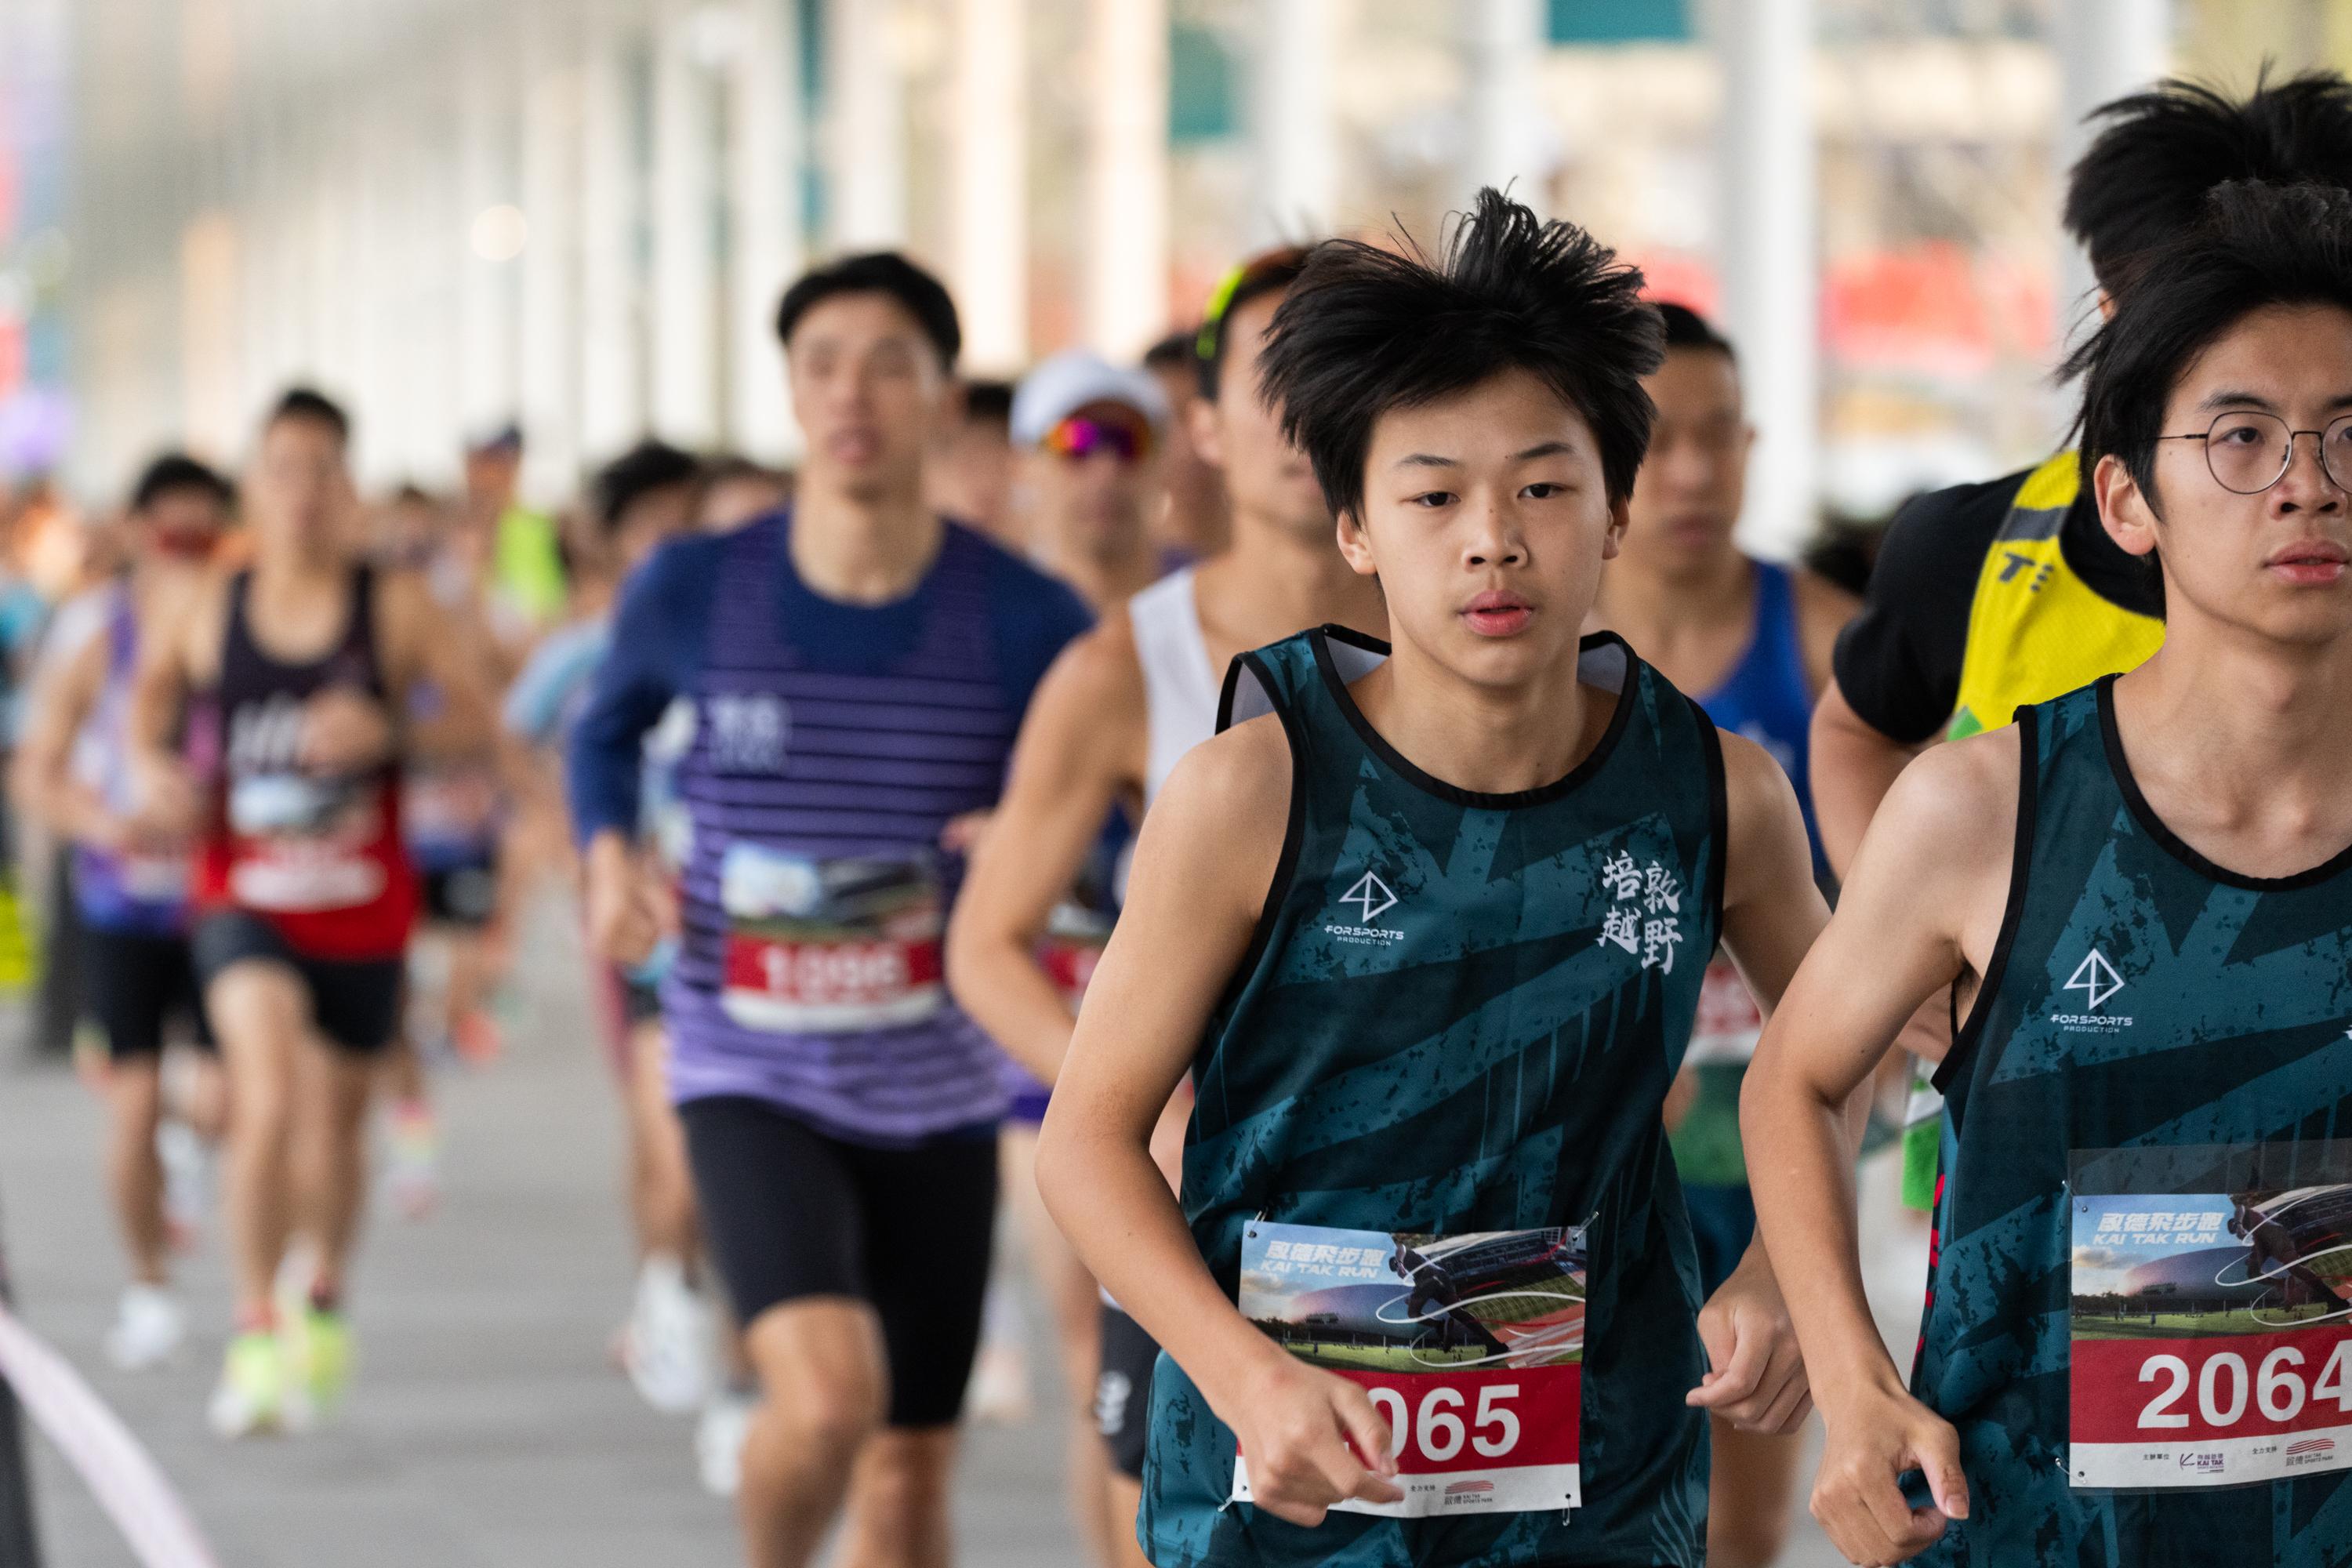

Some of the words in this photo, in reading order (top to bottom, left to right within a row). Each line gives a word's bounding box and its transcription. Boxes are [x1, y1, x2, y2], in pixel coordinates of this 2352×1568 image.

[1324, 925, 1404, 940] FORSPORTS
[1337, 936, 1392, 946] PRODUCTION
[2050, 1014, 2132, 1026] FORSPORTS
[2092, 1234, 2127, 1245] KAI
[2132, 1233, 2171, 1244] TAK
[2175, 1232, 2218, 1243] RUN
[1260, 1260, 1292, 1273] KAI
[1297, 1263, 1334, 1276] TAK
[1338, 1266, 1380, 1279] RUN
[2136, 1339, 2352, 1429] 2064
[1363, 1384, 1521, 1462] 065
